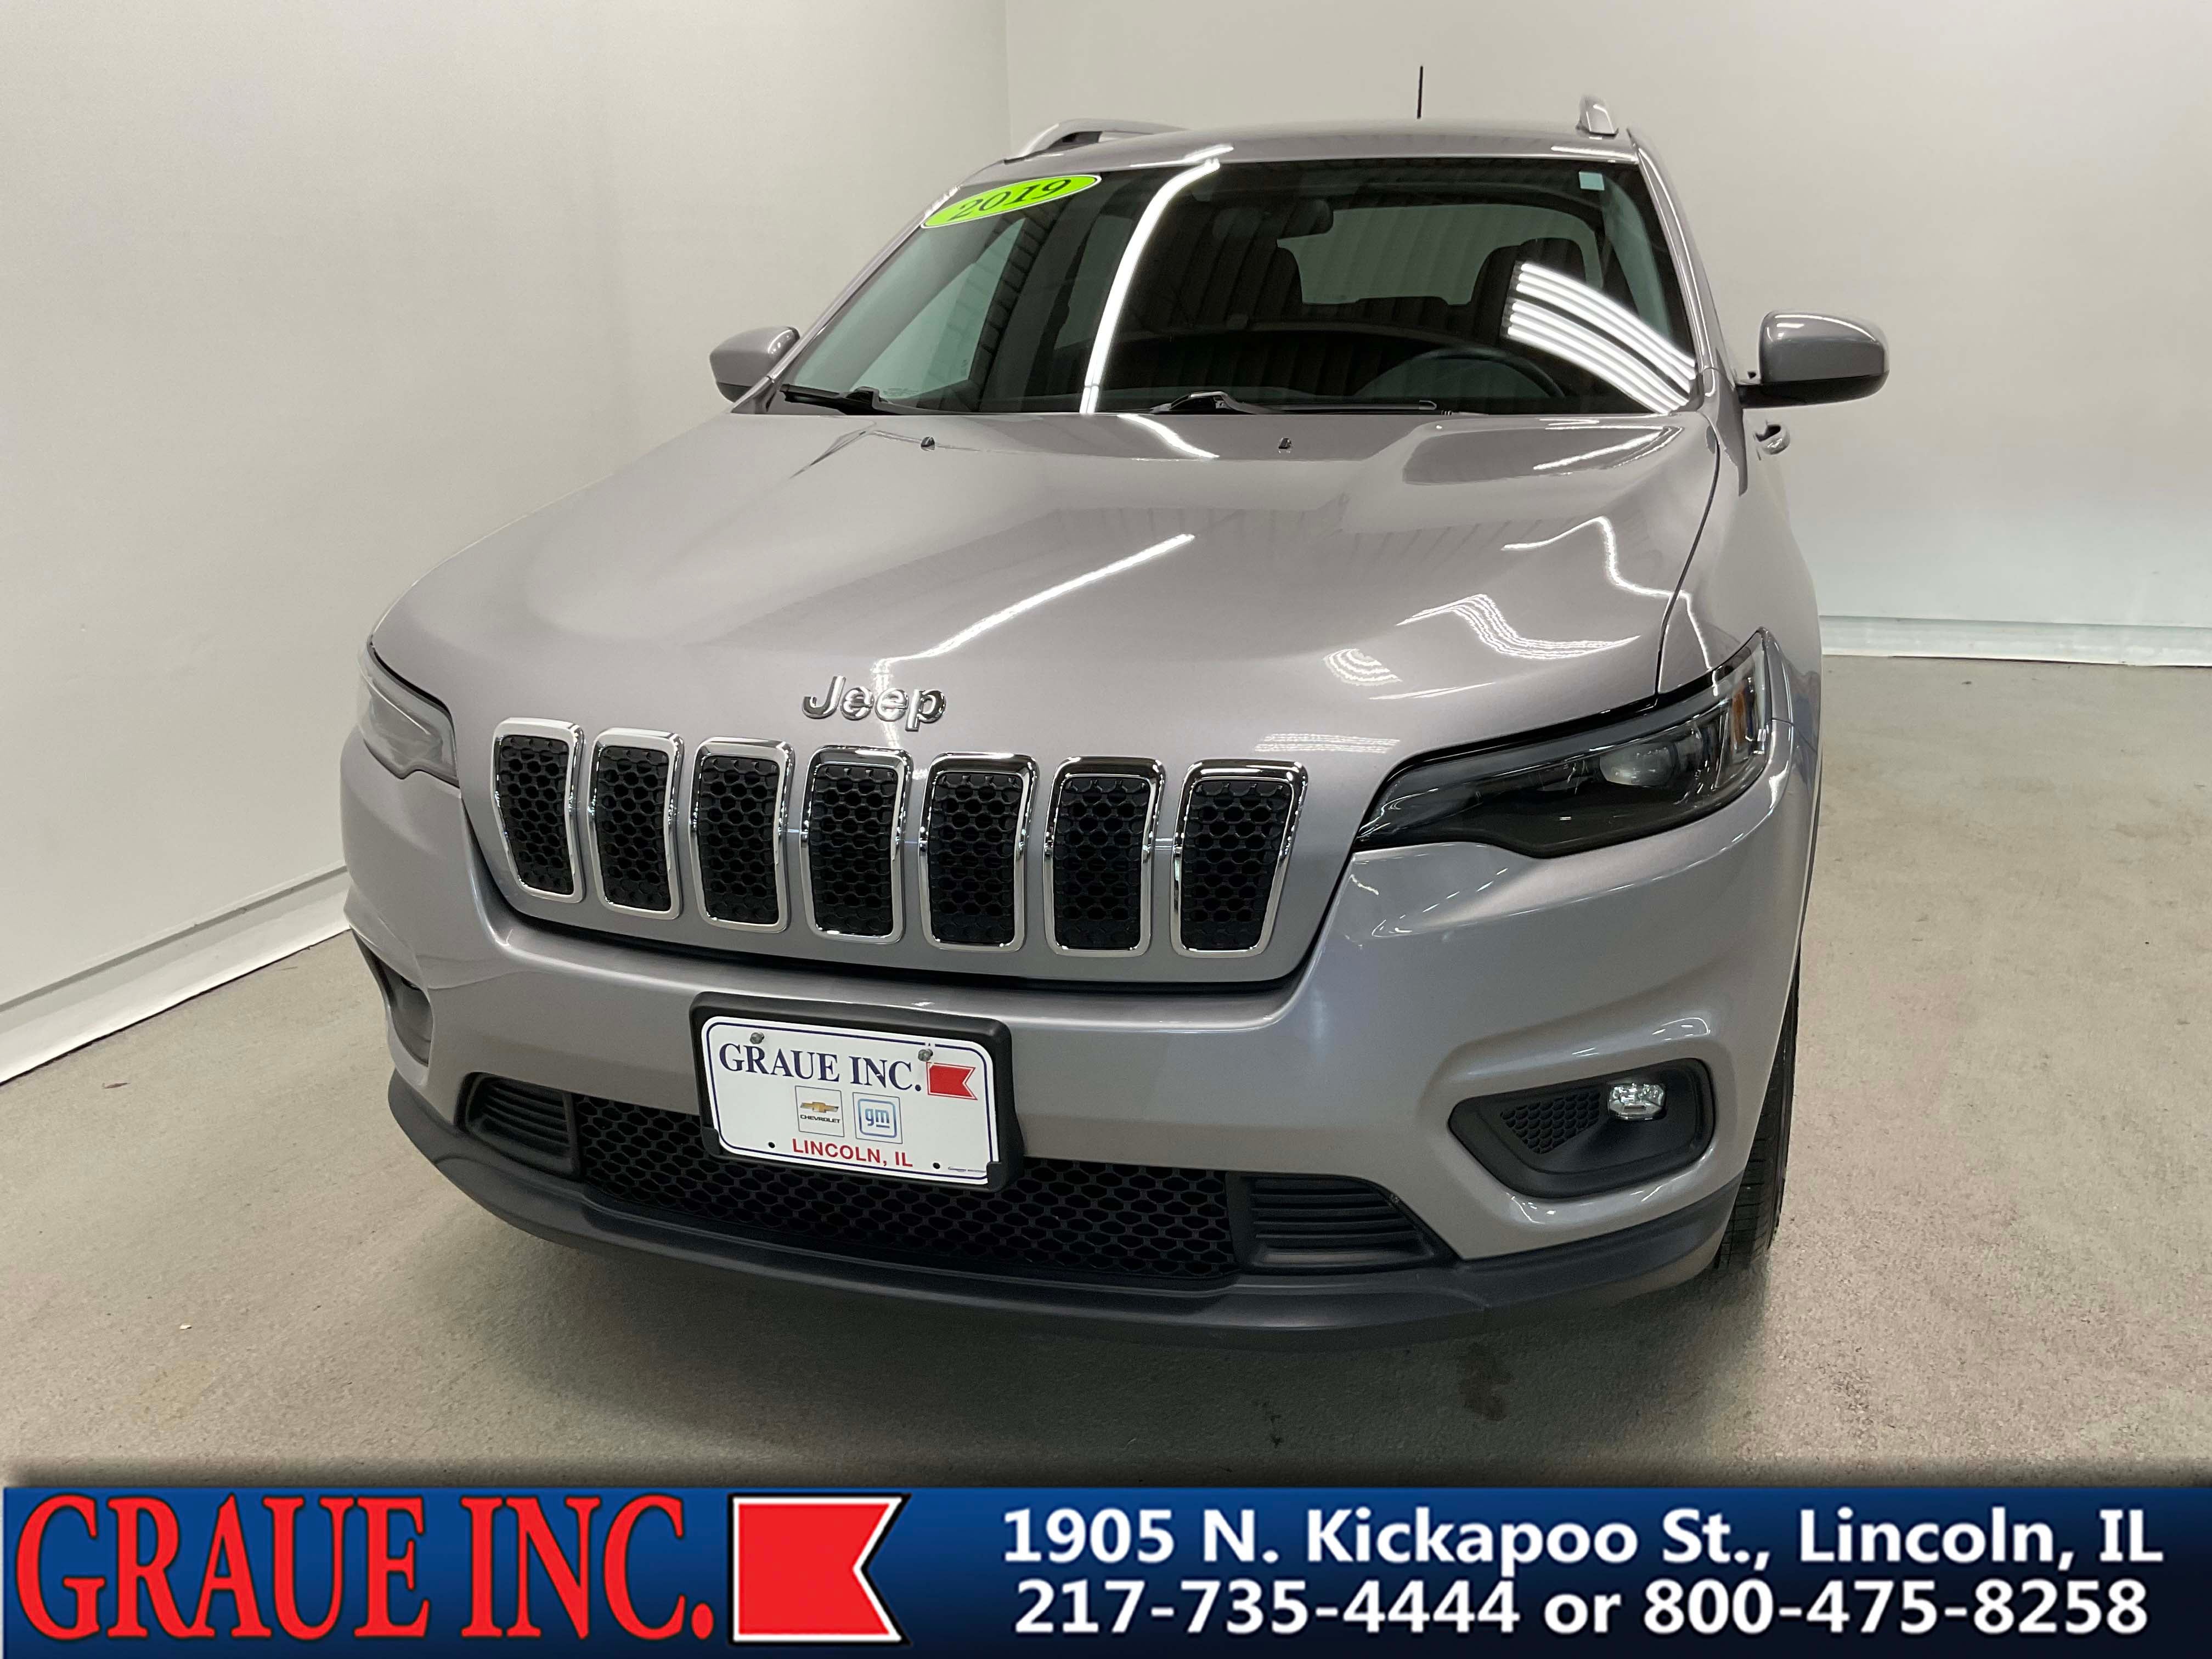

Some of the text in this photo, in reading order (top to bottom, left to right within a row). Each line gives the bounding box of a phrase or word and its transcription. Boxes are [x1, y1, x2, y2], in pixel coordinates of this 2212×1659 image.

[948, 179, 1071, 221] 2019
[802, 675, 946, 731] Jeep
[719, 1043, 922, 1092] GRAUE INC.
[800, 1114, 841, 1124] CHEVROLET
[865, 1108, 890, 1128] gm
[792, 1138, 913, 1167] LINCOLN, IL
